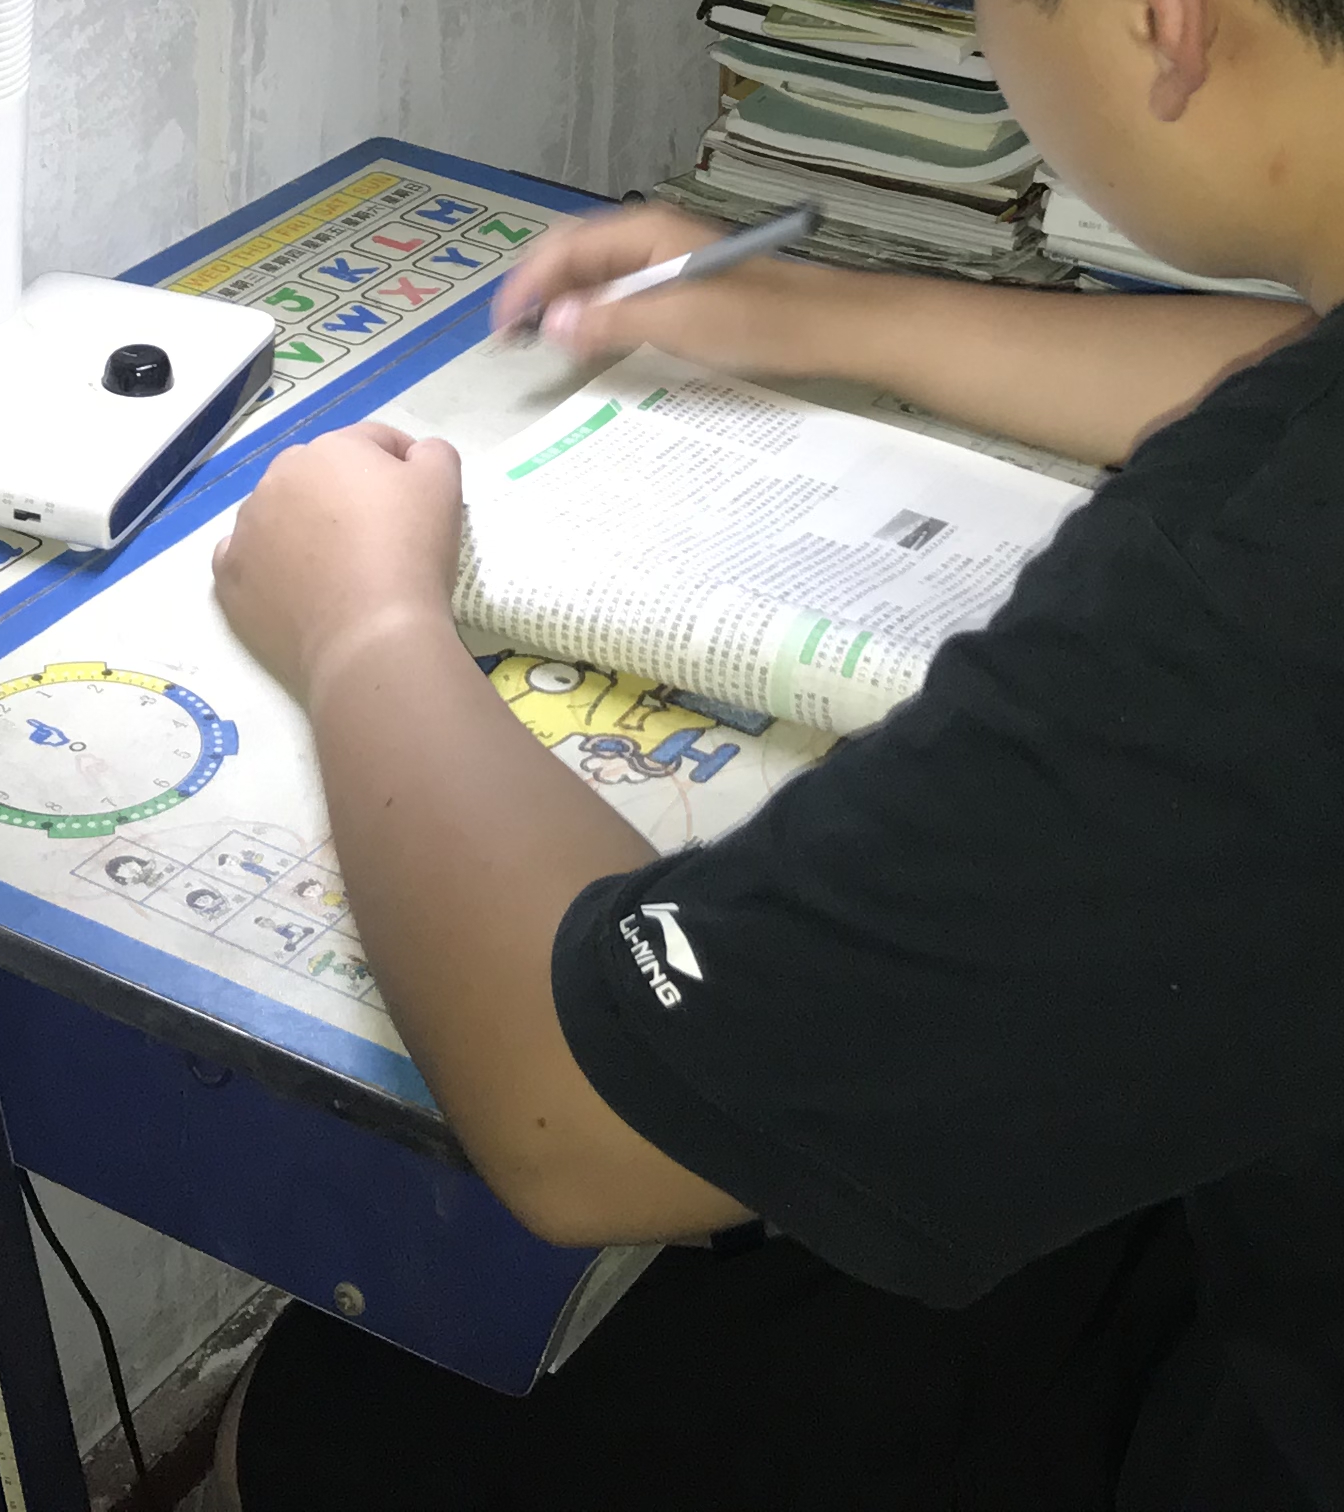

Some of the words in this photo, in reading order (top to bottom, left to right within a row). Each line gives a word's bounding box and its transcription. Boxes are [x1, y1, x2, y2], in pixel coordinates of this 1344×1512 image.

[355, 172, 398, 198] SUN
[380, 181, 428, 208] 星期日
[315, 194, 355, 220] SAT
[341, 203, 384, 229] 星期六
[416, 197, 479, 226] M
[275, 215, 312, 242] FRI
[301, 224, 346, 252] 星期五
[477, 218, 534, 245] Z
[229, 237, 273, 265] THU
[372, 233, 425, 254] L
[259, 246, 305, 275] 星期四
[317, 256, 381, 285] K
[429, 246, 484, 269] Y
[184, 261, 231, 290] WED
[216, 270, 267, 300] 星期三
[264, 285, 316, 314] J
[376, 275, 442, 308] X
[322, 303, 388, 336] W
[274, 340, 326, 365] V
[36, 688, 54, 700] 1
[87, 683, 104, 695] 2
[142, 694, 158, 707] 3
[172, 718, 188, 730] 4
[174, 748, 191, 760] 5
[153, 777, 171, 789] 6
[45, 800, 64, 813] 8
[100, 796, 119, 810] 7
[619, 913, 682, 1009] LI-NING
